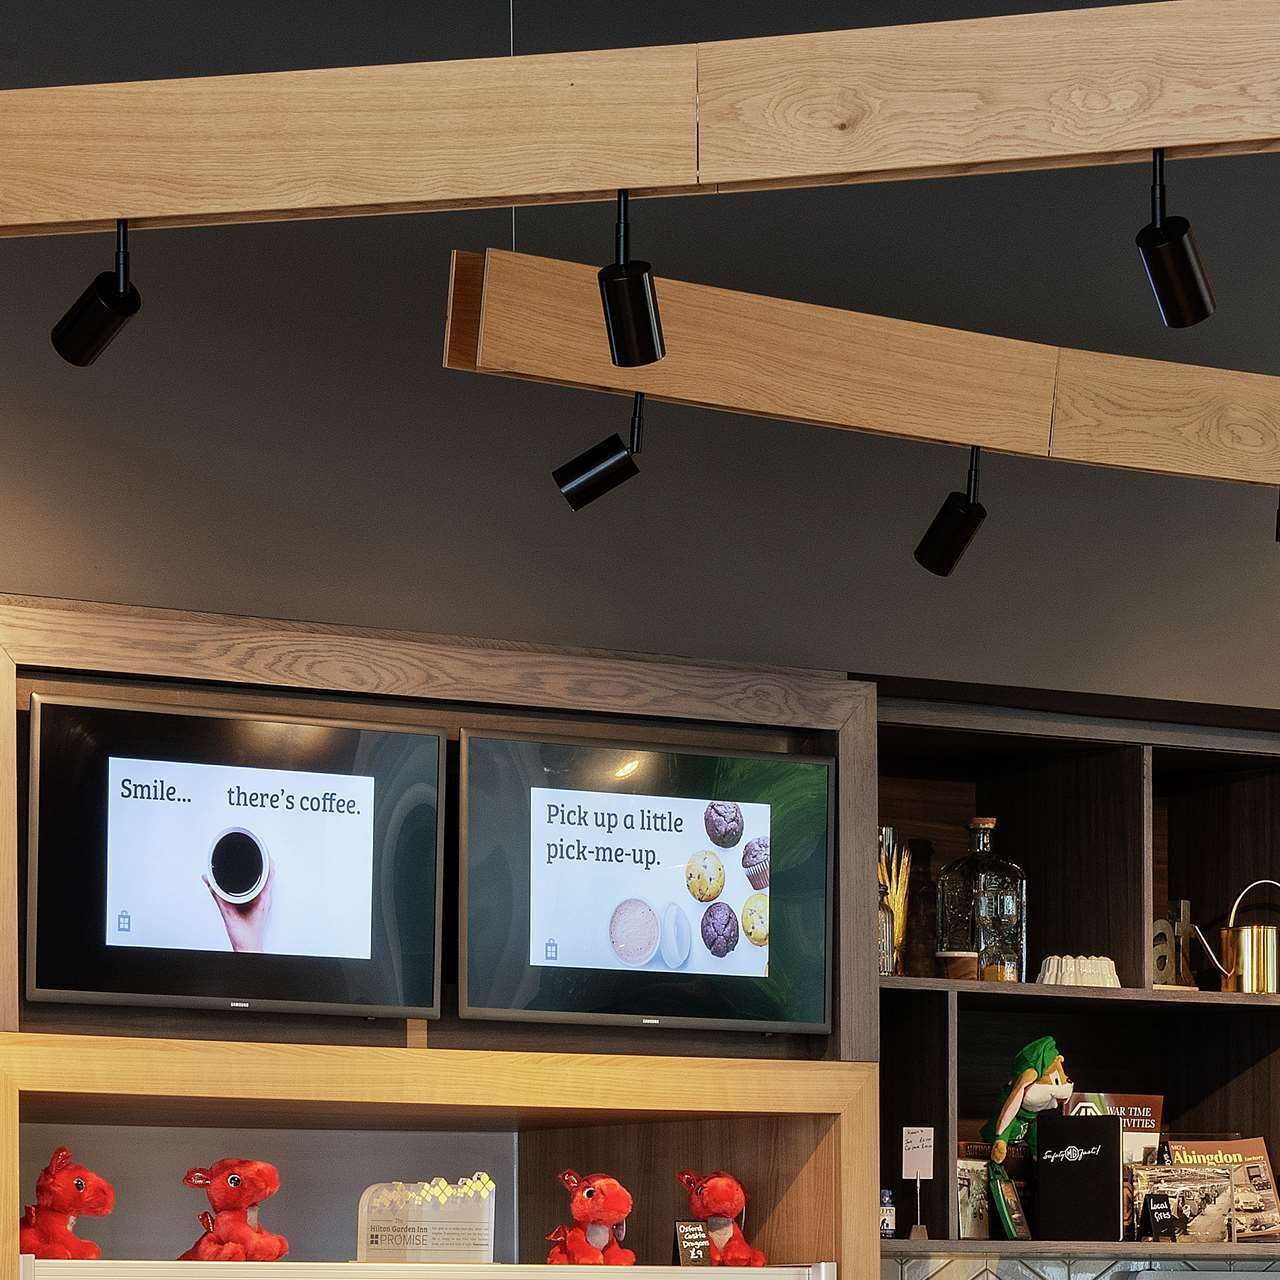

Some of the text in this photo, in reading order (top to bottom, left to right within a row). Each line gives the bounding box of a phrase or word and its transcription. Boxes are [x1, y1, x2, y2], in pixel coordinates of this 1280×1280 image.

[120, 778, 361, 815] Smile... there’s coffee.
[546, 804, 684, 833] Pick up a little
[546, 840, 661, 870] pick-me-up.
[1106, 1107, 1151, 1117] WAR TIME
[1066, 1147, 1079, 1160] MG
[1173, 1151, 1243, 1166] Abingdon
[392, 1225, 416, 1233] Garden
[380, 1234, 428, 1245] PROMISE
